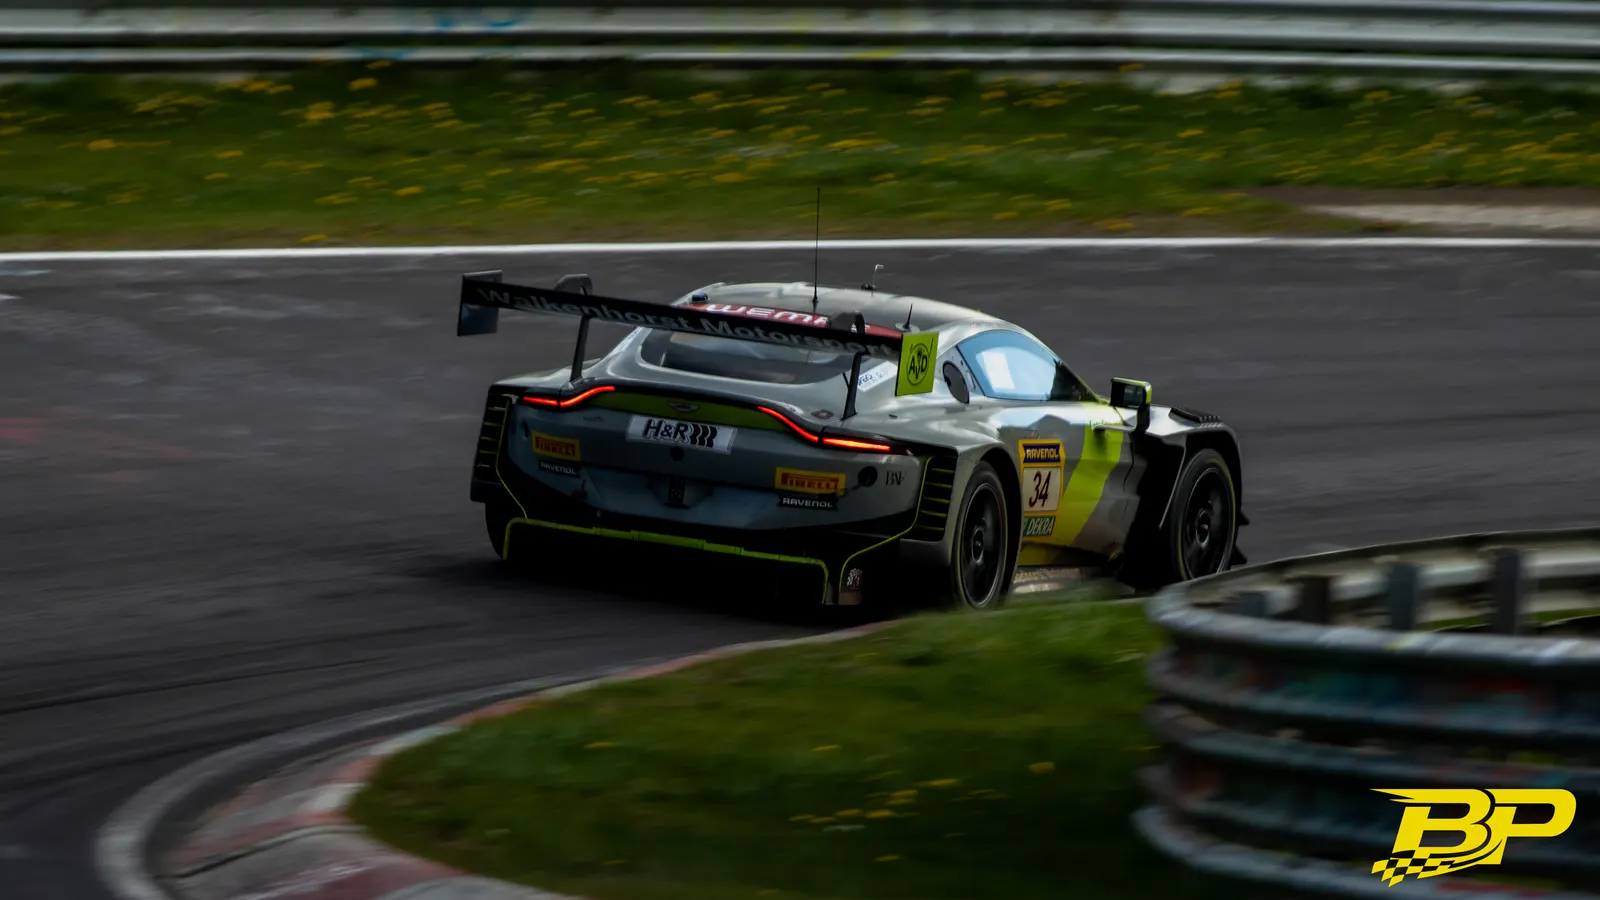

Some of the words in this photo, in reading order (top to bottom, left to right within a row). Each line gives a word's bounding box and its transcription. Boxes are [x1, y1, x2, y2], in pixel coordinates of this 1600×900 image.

[475, 286, 692, 330] Walkenhorst
[698, 317, 893, 358] Motorsport
[642, 418, 690, 442] H&R
[1026, 447, 1059, 460] RAVENOL
[540, 461, 577, 475] RAVENOL
[781, 472, 840, 491] PIRELLI
[1028, 471, 1051, 508] 34
[782, 497, 834, 508] RAVENOL
[1026, 516, 1054, 536] DEKRA
